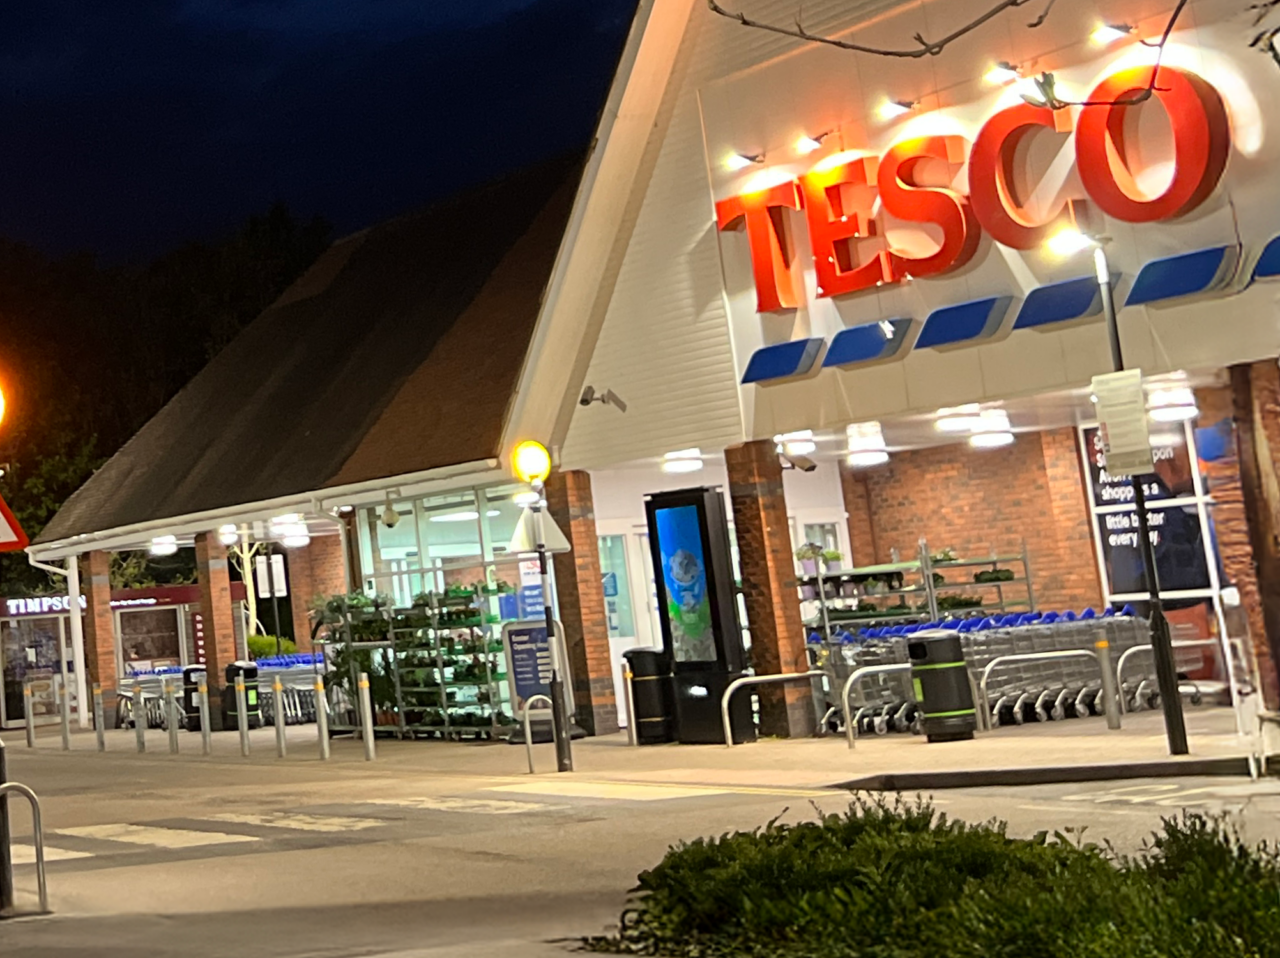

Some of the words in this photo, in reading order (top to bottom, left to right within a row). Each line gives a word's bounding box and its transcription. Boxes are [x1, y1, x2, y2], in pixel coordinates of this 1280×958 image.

[715, 64, 1231, 314] TESCO
[1109, 530, 1138, 547] every
[7, 595, 87, 614] TIMPSON
